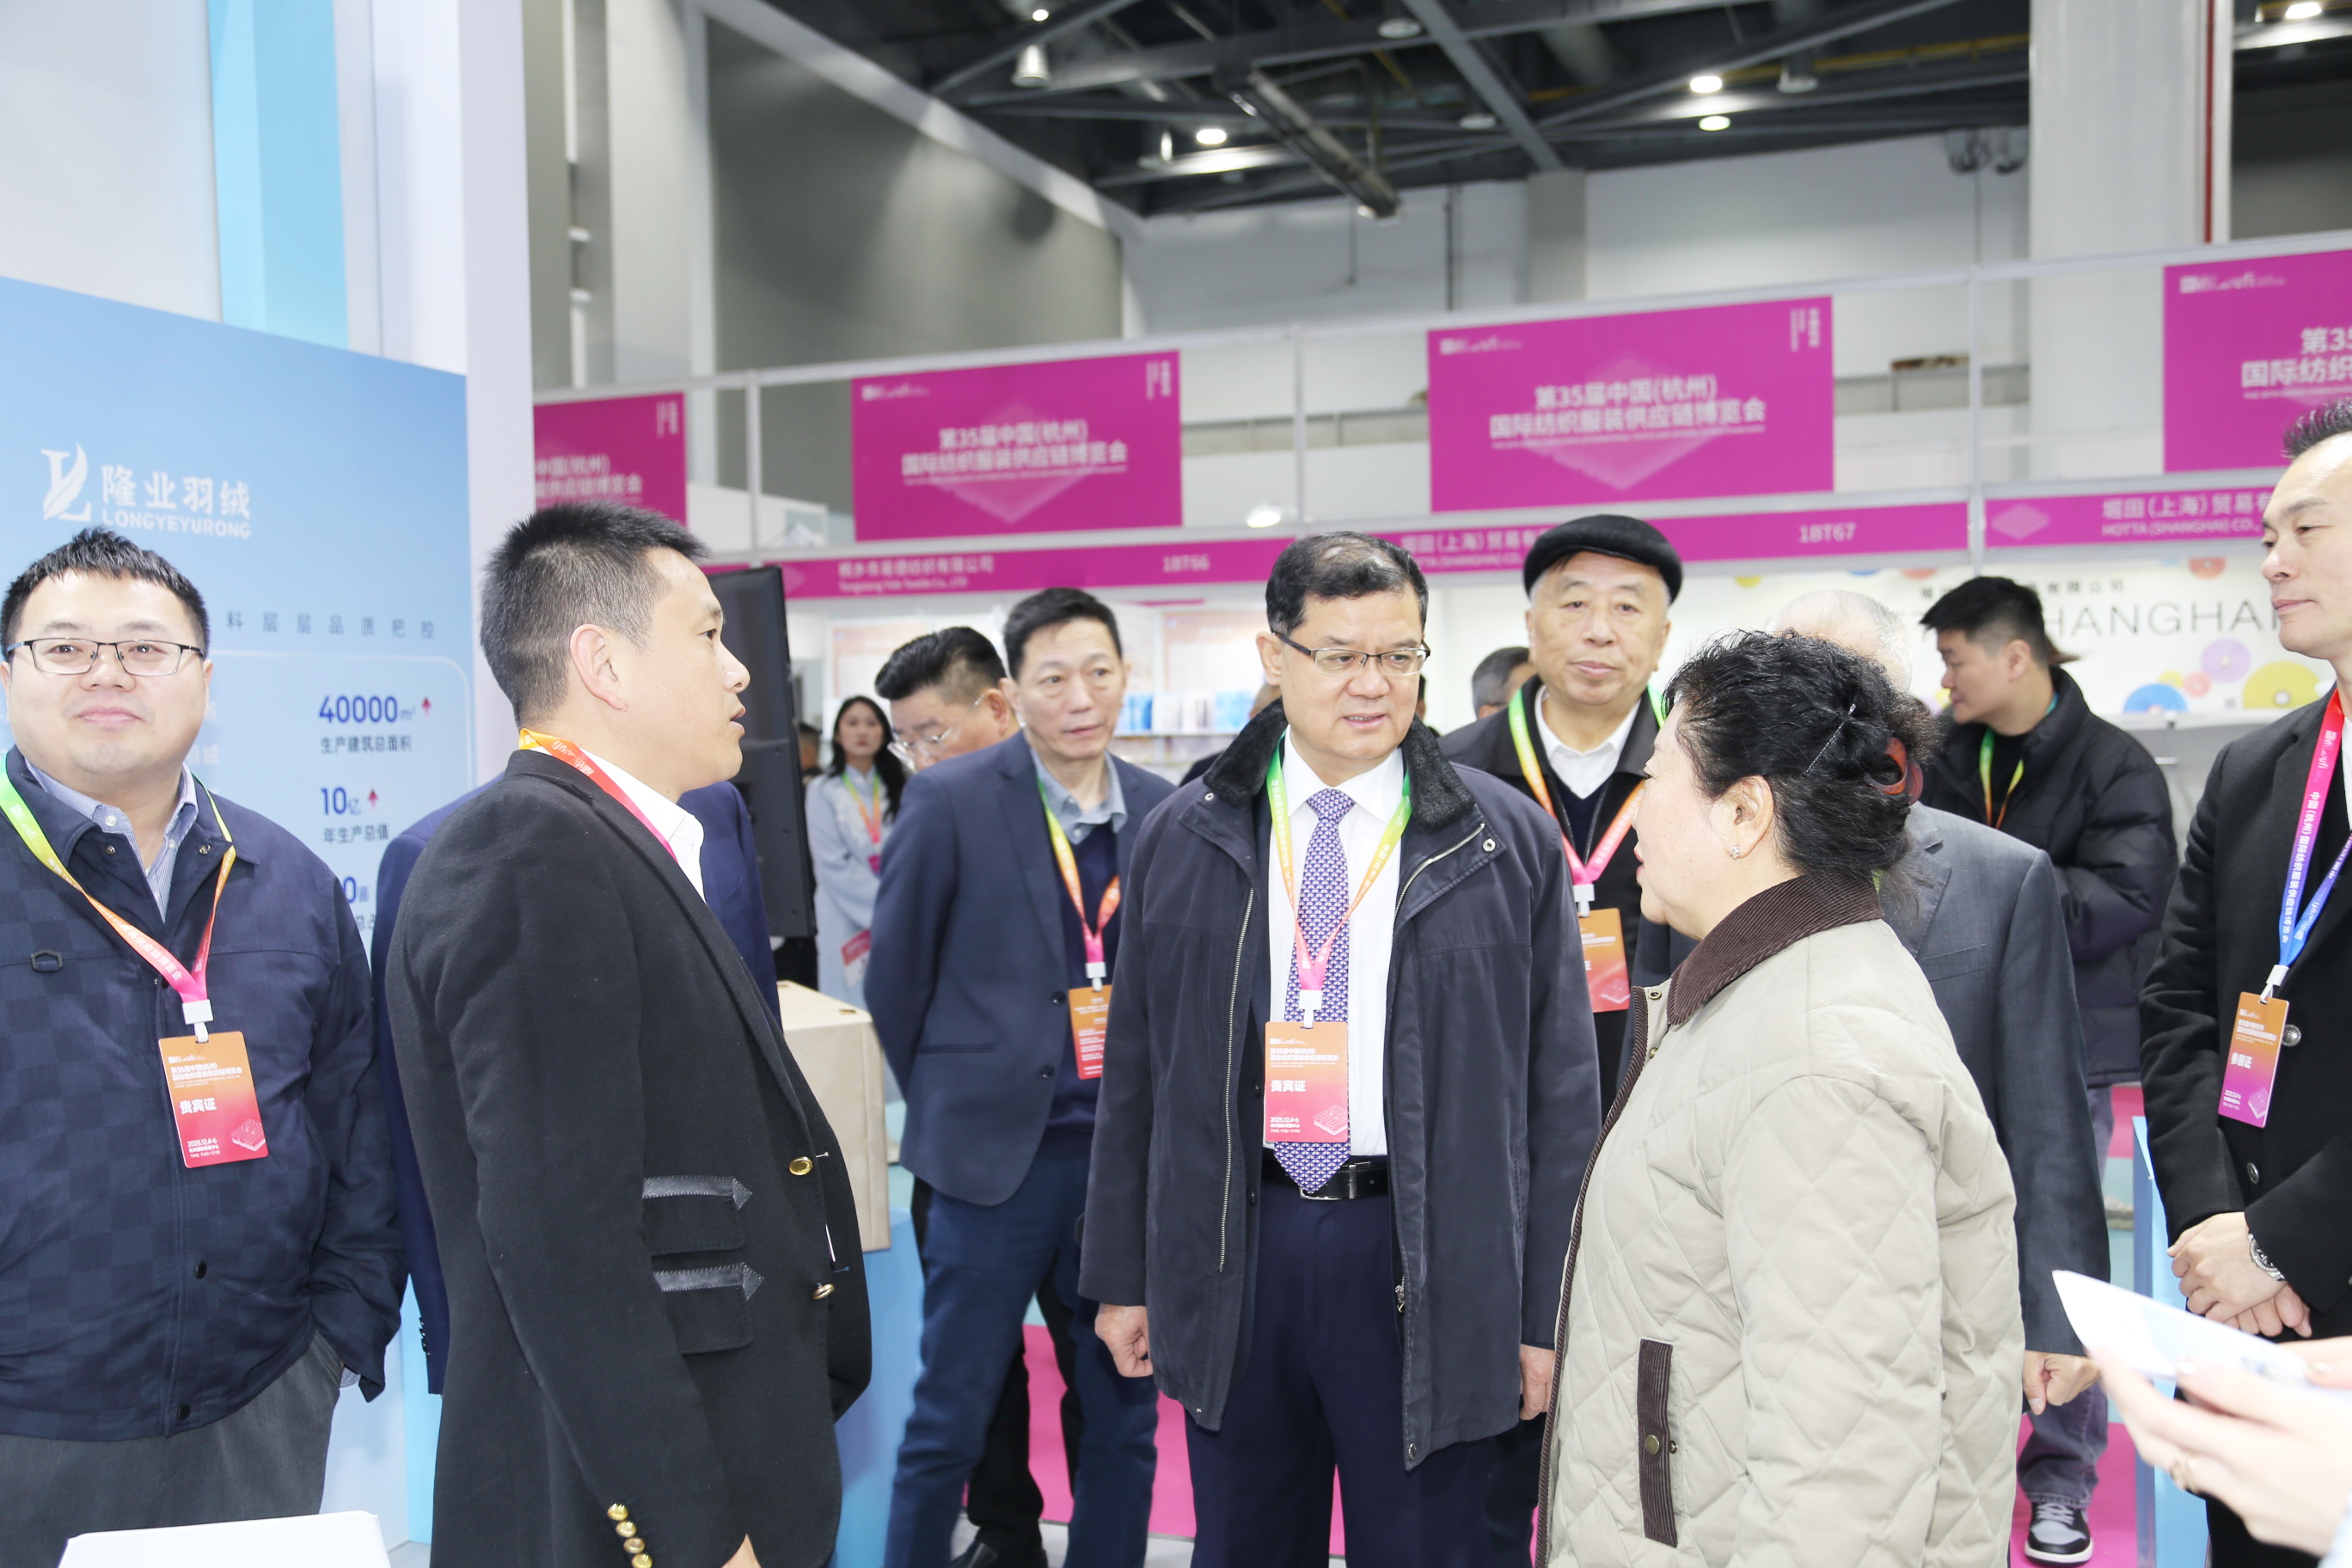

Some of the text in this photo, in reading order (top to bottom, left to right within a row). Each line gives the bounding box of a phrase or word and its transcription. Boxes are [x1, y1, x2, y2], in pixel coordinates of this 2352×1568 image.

[2300, 326, 2352, 355] 第3
[101, 463, 252, 521] 隆业羽绒
[101, 508, 252, 540] LONGYEYURONG
[1798, 523, 1857, 545] 1BT67
[2102, 521, 2147, 537] HOTTA
[320, 735, 413, 755] 生产建筑总面积
[323, 823, 389, 844] 年生产总值
[1271, 1080, 1307, 1093] 贵宾证
[179, 1097, 217, 1115] 贵宾证
[187, 1138, 217, 1148] 2025.12.4-6
